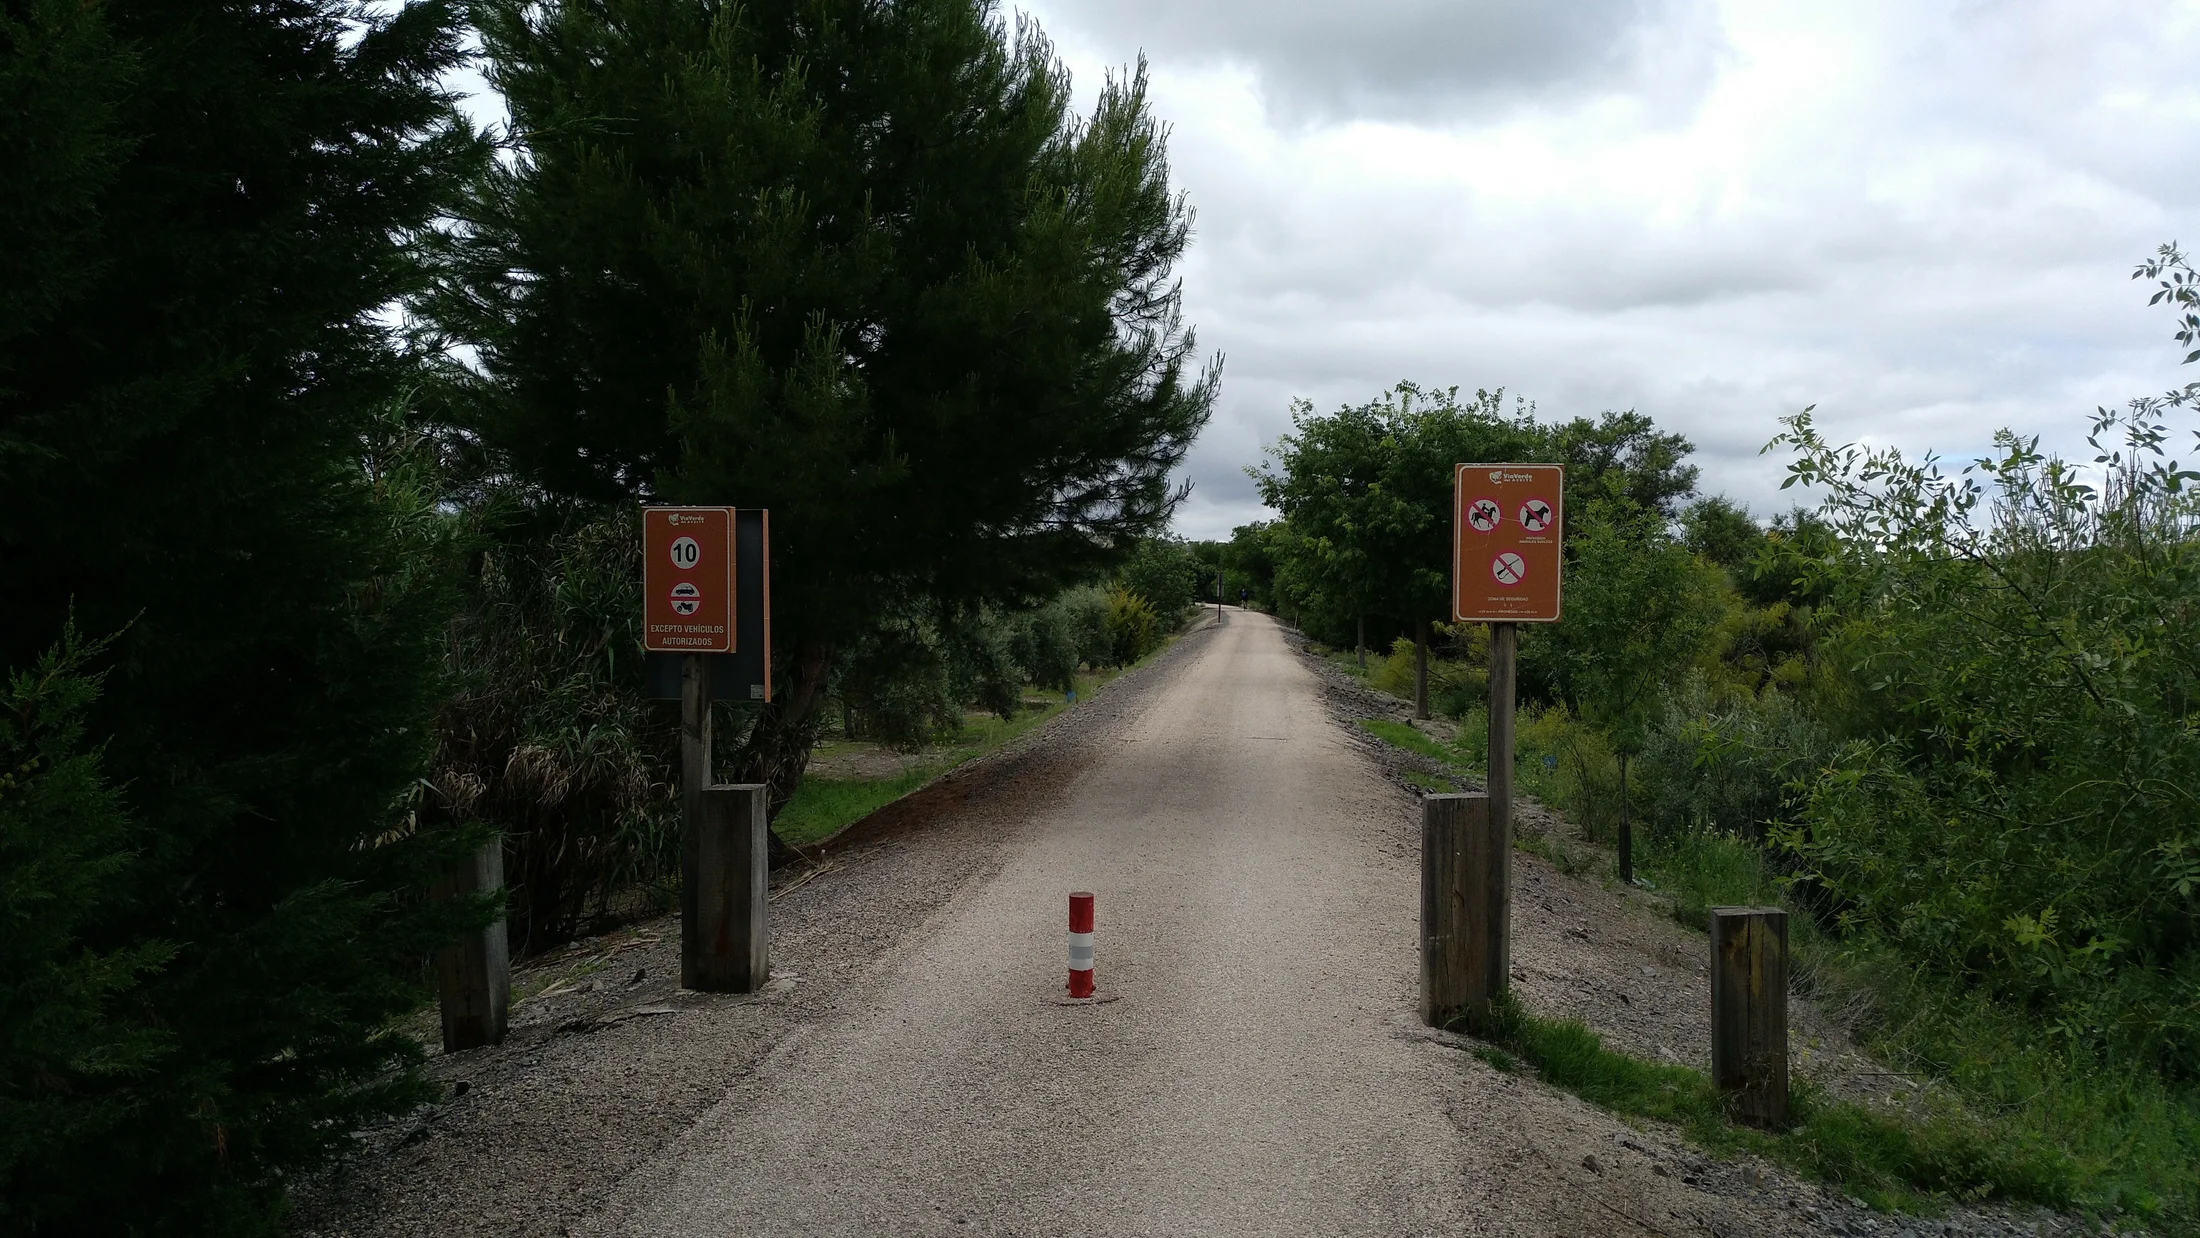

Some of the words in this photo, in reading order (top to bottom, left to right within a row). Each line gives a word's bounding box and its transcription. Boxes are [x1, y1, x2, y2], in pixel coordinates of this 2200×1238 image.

[673, 543, 697, 562] 10
[650, 624, 682, 633] EXCEPTO
[684, 623, 724, 634] VEHÍCULOS
[662, 637, 713, 646] AUTORIZADOS
